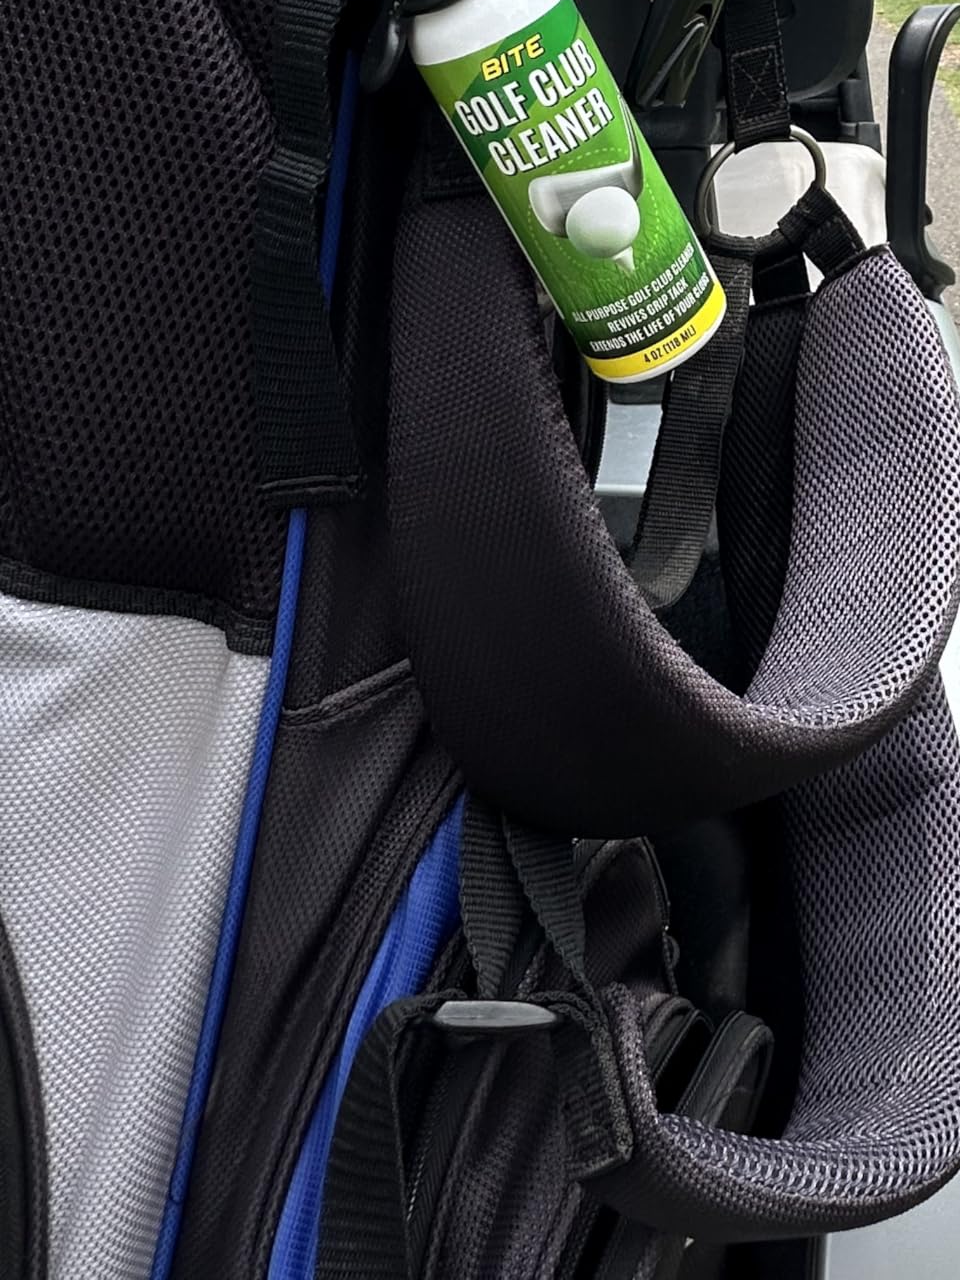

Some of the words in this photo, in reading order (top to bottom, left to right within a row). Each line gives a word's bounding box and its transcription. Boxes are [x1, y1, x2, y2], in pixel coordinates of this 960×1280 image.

[454, 81, 529, 136] GOLF
[528, 38, 597, 107] CLUB
[481, 33, 545, 81] BITE
[488, 87, 614, 176] CLEANER
[571, 311, 588, 323] ALL
[586, 298, 629, 322] PURPOSE
[627, 286, 653, 307] GOLF
[651, 269, 674, 293] CLUB
[672, 241, 695, 277] CLEANER
[607, 307, 648, 333] REVIVES
[647, 294, 669, 316] GRIP
[667, 276, 689, 301] TACK
[589, 336, 627, 352] EXTENDS
[624, 329, 646, 345] THE
[643, 319, 665, 337] LIFE
[663, 309, 676, 326] OF
[674, 292, 696, 317] YOUR
[643, 353, 651, 363] 4
[651, 348, 664, 361] OZ
